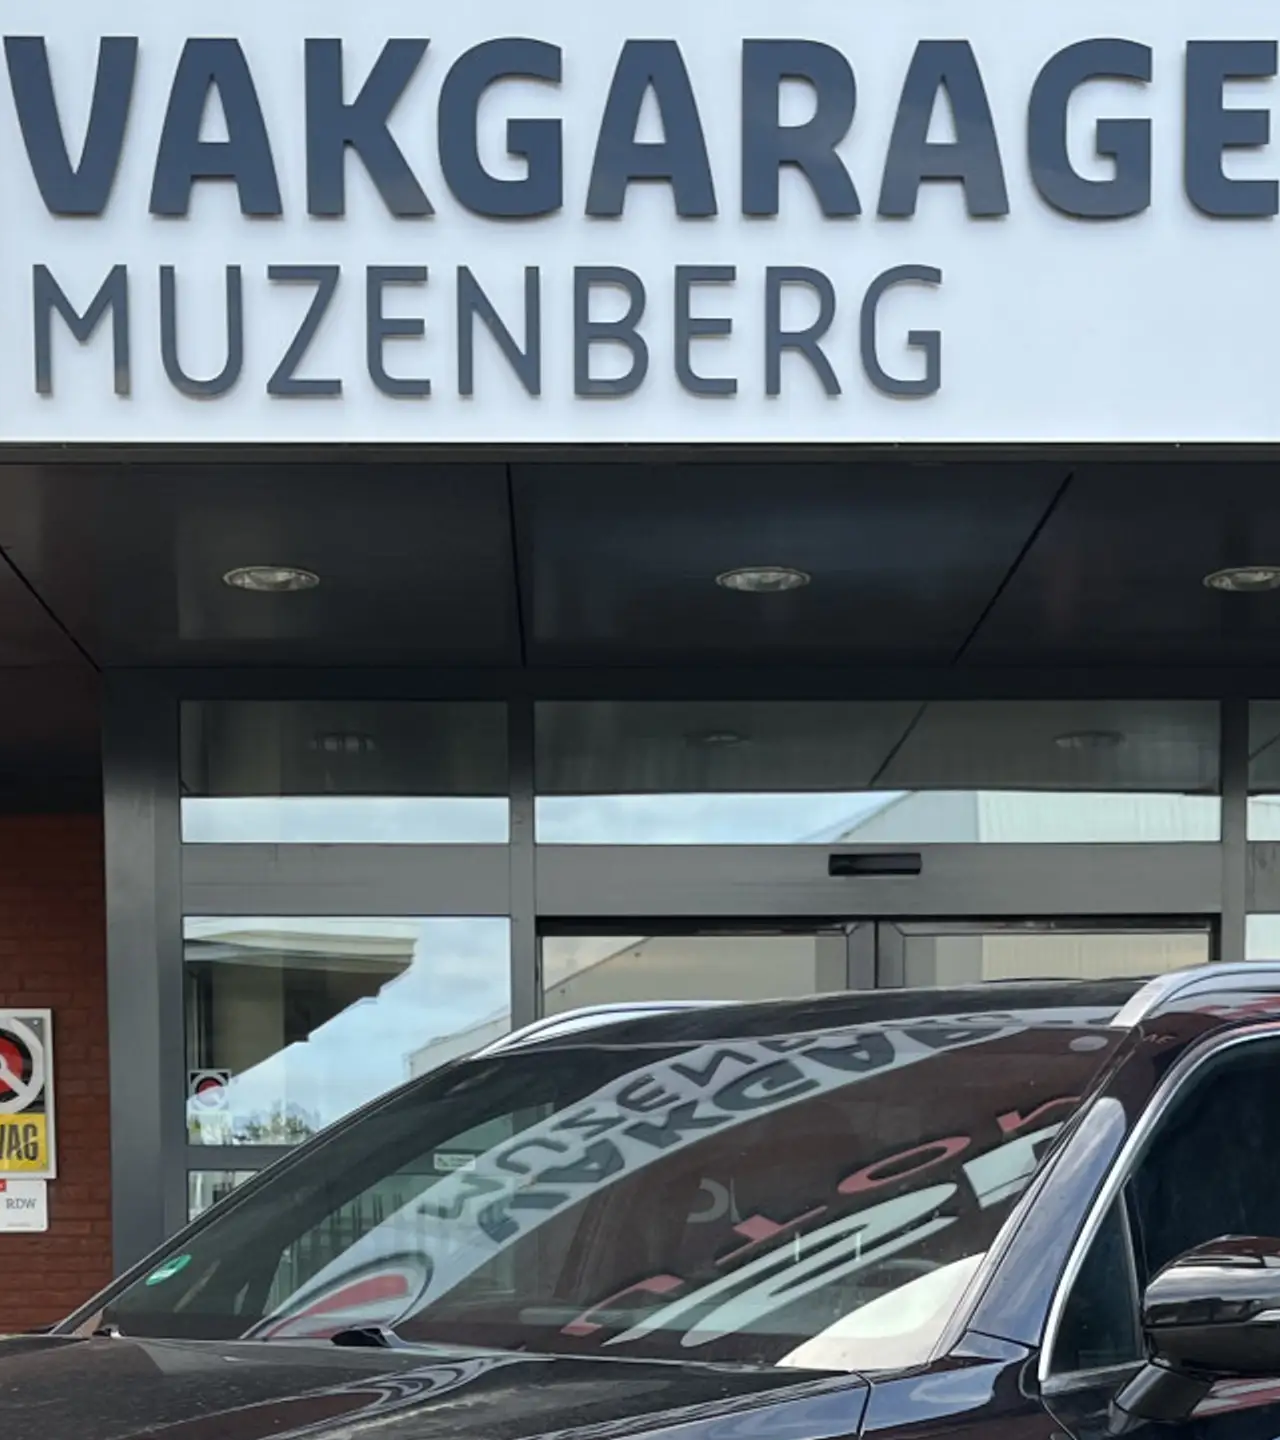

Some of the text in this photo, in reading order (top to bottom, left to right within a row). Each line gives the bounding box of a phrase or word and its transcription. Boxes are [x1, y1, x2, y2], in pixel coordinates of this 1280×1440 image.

[3, 36, 1280, 222] VAKGARAGE
[33, 264, 942, 401] MUZENBERG
[6, 1198, 37, 1210] RDW
